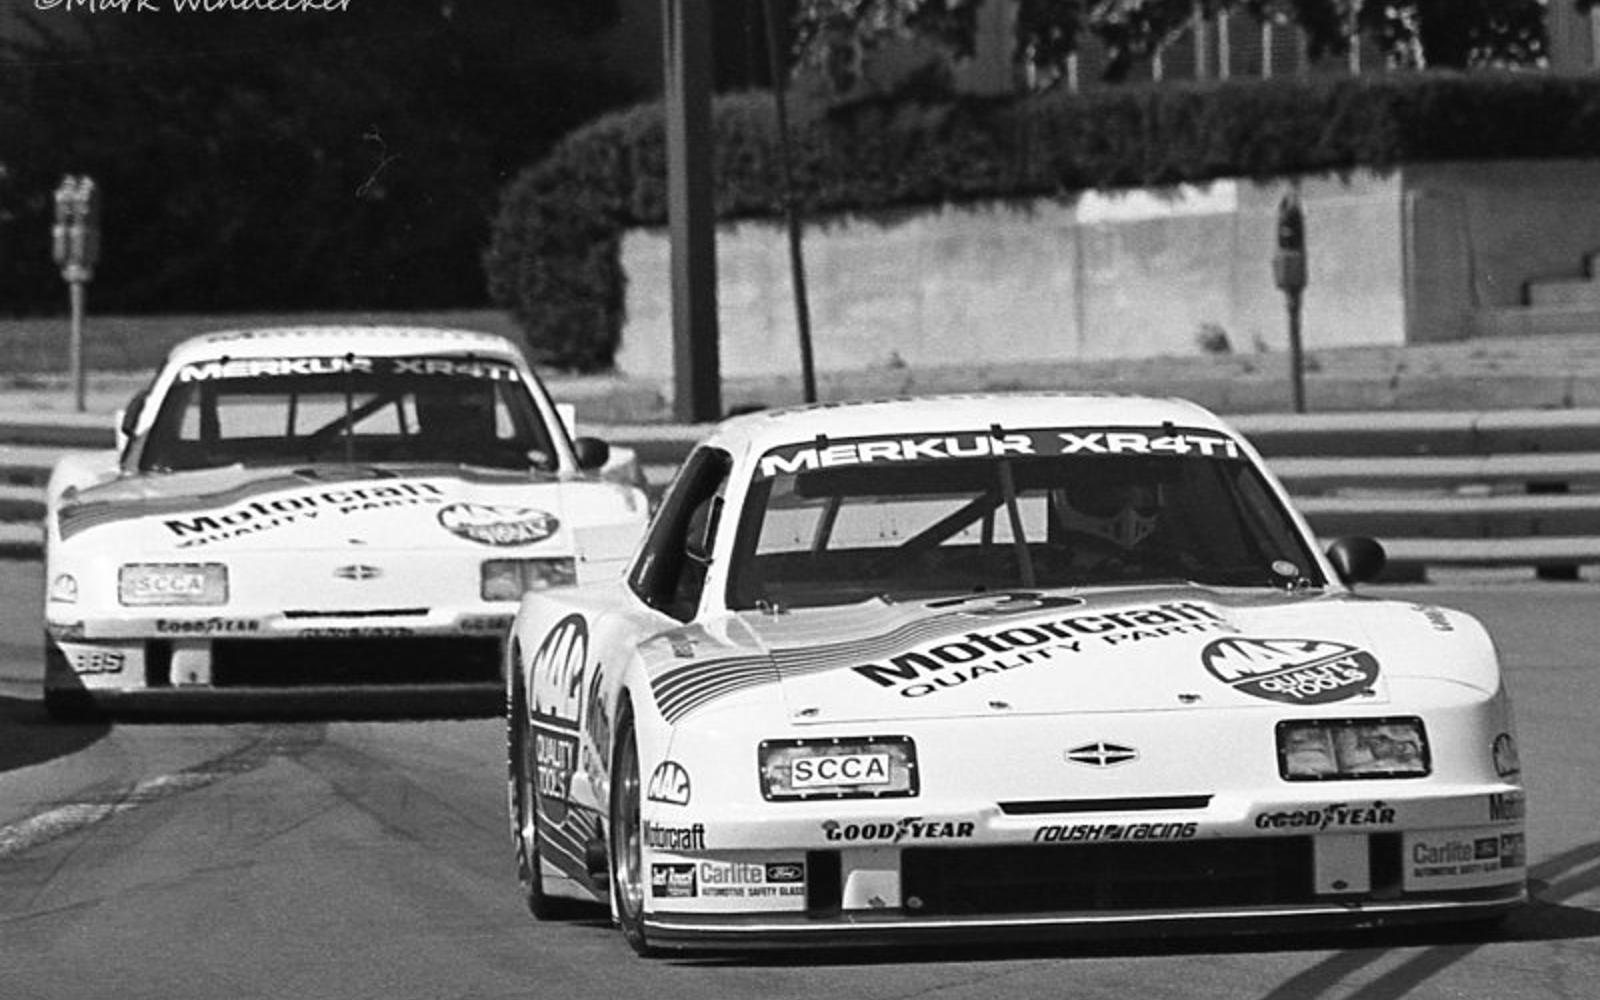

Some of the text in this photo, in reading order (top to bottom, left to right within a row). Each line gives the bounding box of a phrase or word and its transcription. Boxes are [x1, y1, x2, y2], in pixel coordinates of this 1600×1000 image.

[180, 356, 372, 382] MERKUR
[761, 431, 1239, 476] MERKUR XR4Ti
[163, 482, 445, 537] Motorcraft
[134, 576, 202, 592] SCCA
[850, 600, 1228, 688] Motorcraft
[900, 620, 1241, 699] QUALITY PARTS
[1258, 656, 1361, 693] QUALITY
[1286, 669, 1368, 698] TOOLS
[795, 757, 885, 782] SCCA
[643, 820, 705, 849] Motorcraft
[700, 862, 763, 884] Carlite
